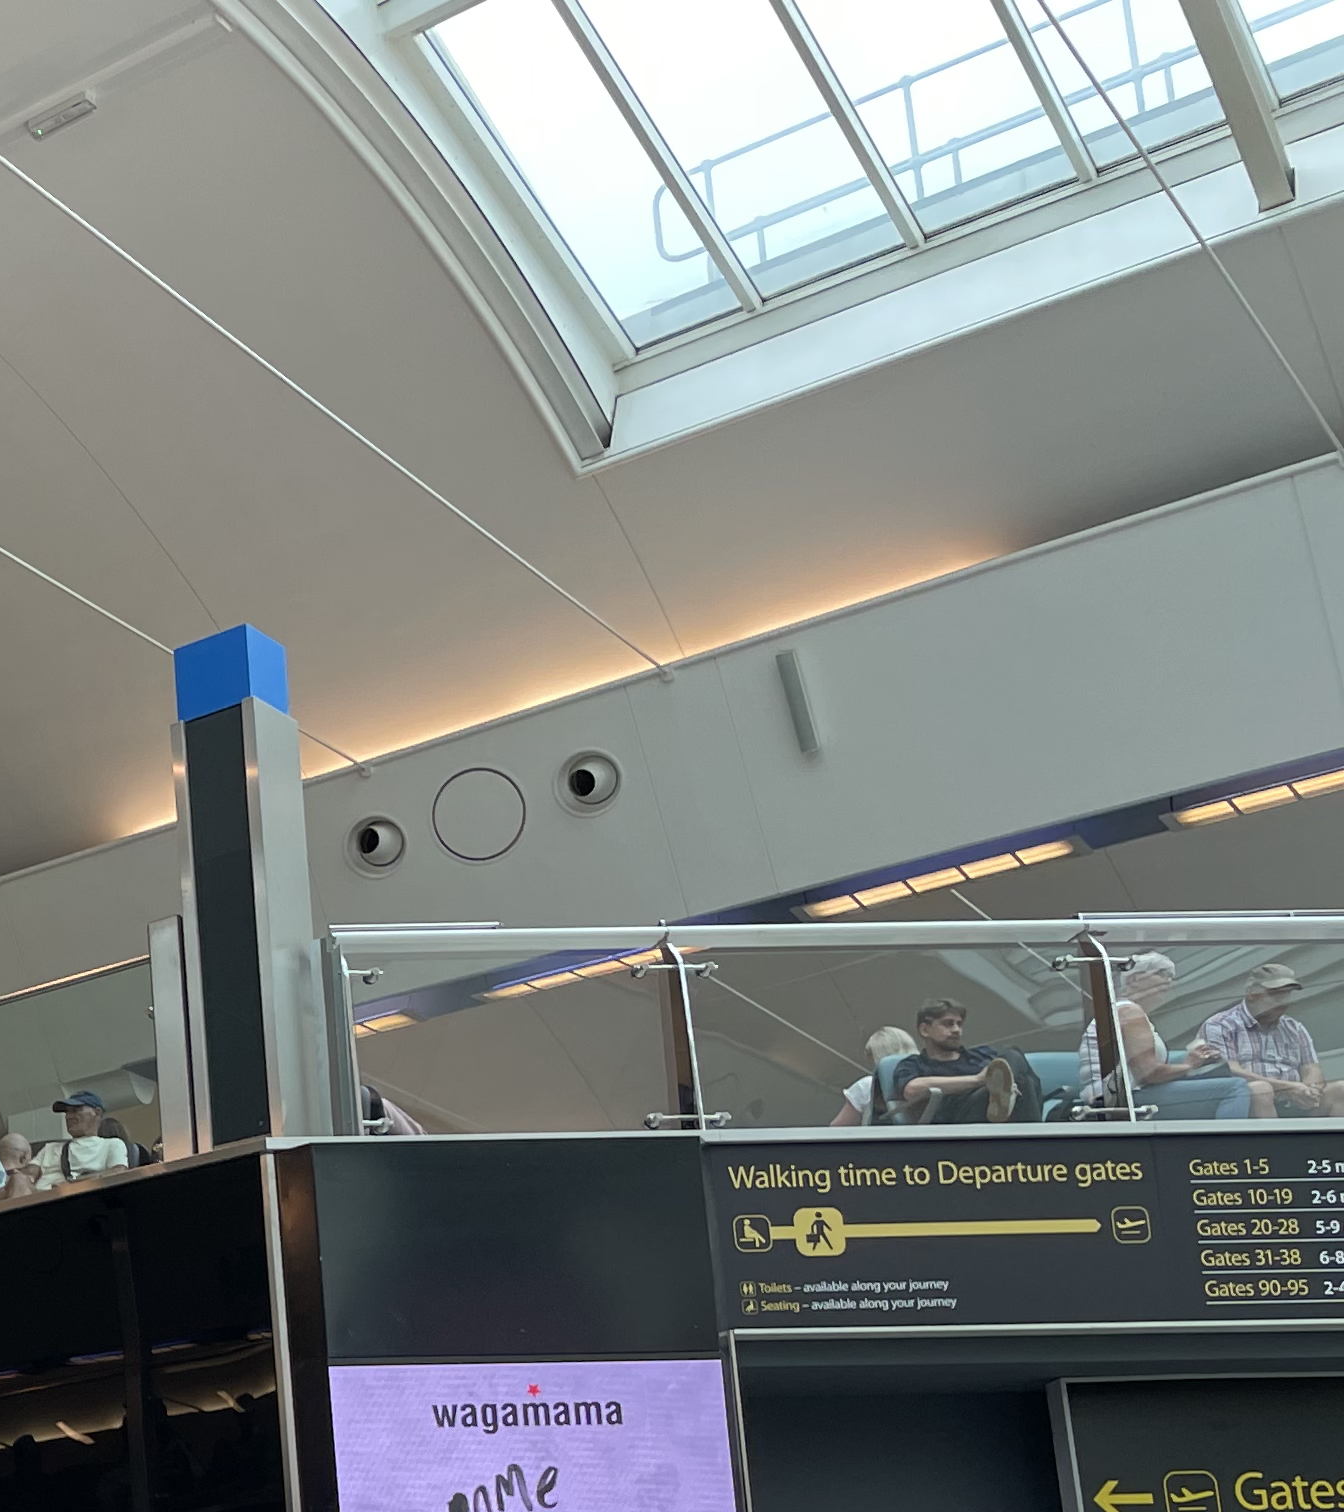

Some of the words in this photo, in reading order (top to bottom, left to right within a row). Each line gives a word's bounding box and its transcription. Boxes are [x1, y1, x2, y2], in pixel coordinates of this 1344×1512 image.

[727, 1164, 831, 1193] Walking
[838, 1163, 897, 1187] time
[903, 1163, 930, 1186] to
[938, 1160, 1068, 1189] Departure
[1074, 1159, 1143, 1188] gates
[1189, 1159, 1239, 1176] Gates
[1243, 1158, 1270, 1175] 1-5
[1307, 1159, 1332, 1174] 2-5
[1192, 1189, 1243, 1206] Gates
[1247, 1188, 1293, 1205] 10-19
[1311, 1189, 1337, 1204] 2-6
[1196, 1219, 1247, 1236] Gates
[1250, 1218, 1300, 1235] 20-28
[1315, 1219, 1340, 1234] 5-9
[1200, 1249, 1251, 1267] Gates
[1254, 1249, 1301, 1265] 31-38
[1319, 1250, 1344, 1265] 6-8
[758, 1282, 792, 1294] Toilets
[803, 1280, 849, 1292] available
[851, 1280, 881, 1293] along
[882, 1280, 907, 1293] your
[909, 1279, 949, 1292] journey
[1204, 1280, 1255, 1297] Gates
[1258, 1279, 1309, 1296] 90-95
[760, 1300, 800, 1313] Seating
[811, 1298, 857, 1310] available
[859, 1298, 889, 1311] along
[891, 1299, 915, 1311] your
[917, 1297, 957, 1310] journey
[432, 1398, 624, 1434] wagamama
